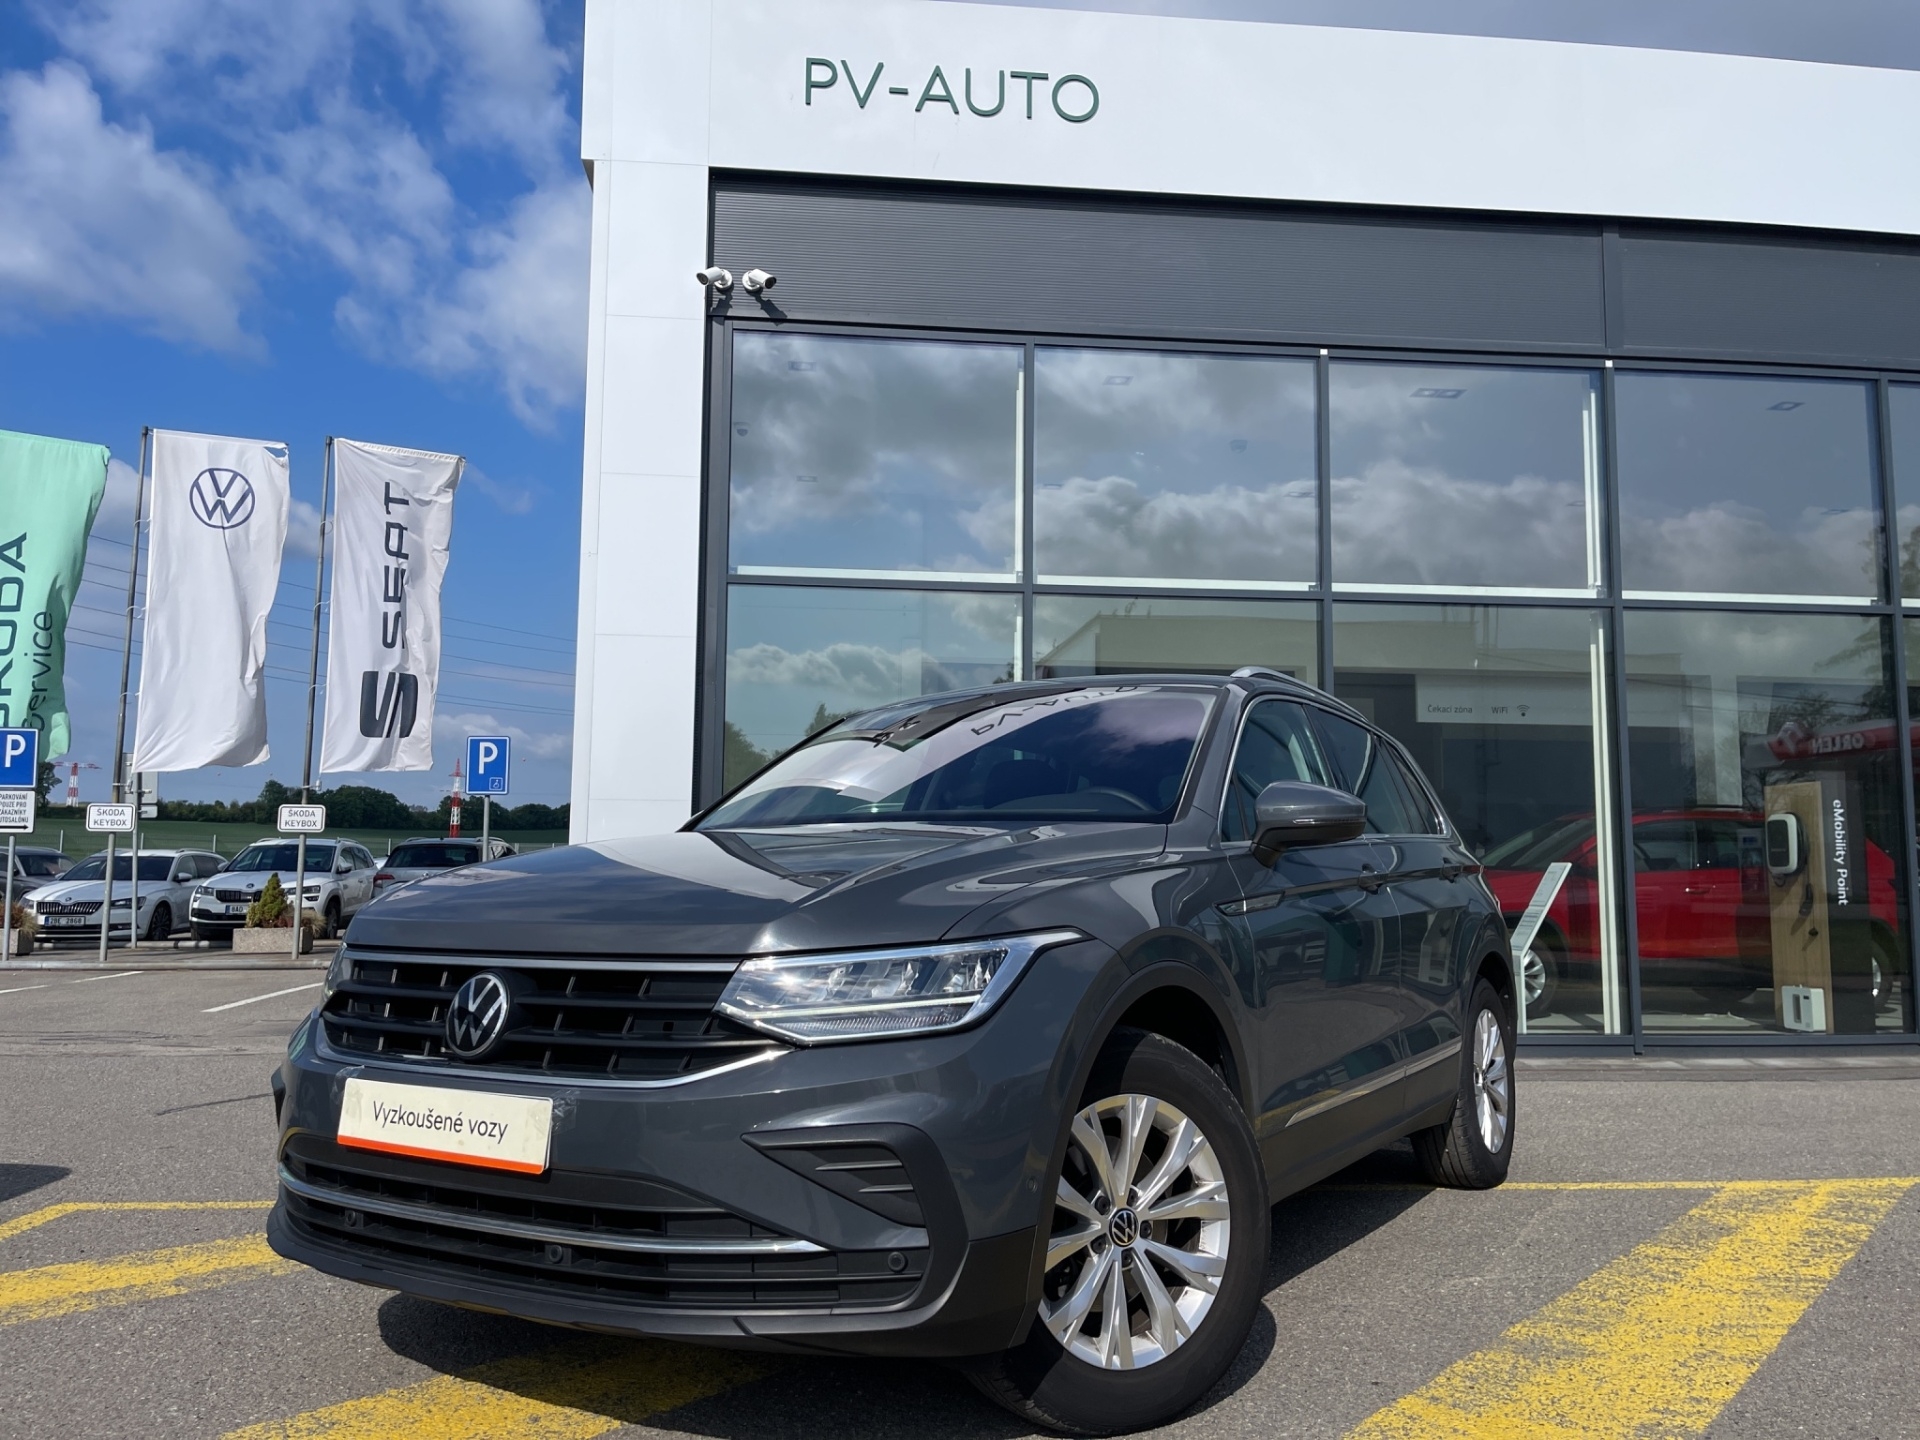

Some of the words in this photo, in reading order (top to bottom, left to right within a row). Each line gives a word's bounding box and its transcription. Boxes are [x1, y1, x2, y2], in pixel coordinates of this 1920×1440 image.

[805, 57, 1100, 123] PV-AUTO
[382, 481, 410, 649] SEAT
[0, 532, 27, 728] ODA
[1427, 704, 1452, 713] Čekací
[1454, 705, 1473, 713] zóna
[5, 734, 26, 768] P
[478, 741, 498, 775] P
[96, 808, 126, 816] ŠKODA
[285, 819, 317, 827] KEYBOX
[288, 809, 316, 817] ŠKODA
[1832, 799, 1847, 865] eMobility
[1836, 868, 1849, 906] Point
[373, 1100, 463, 1134] Vyzkoušené
[468, 1116, 508, 1144] vozy
